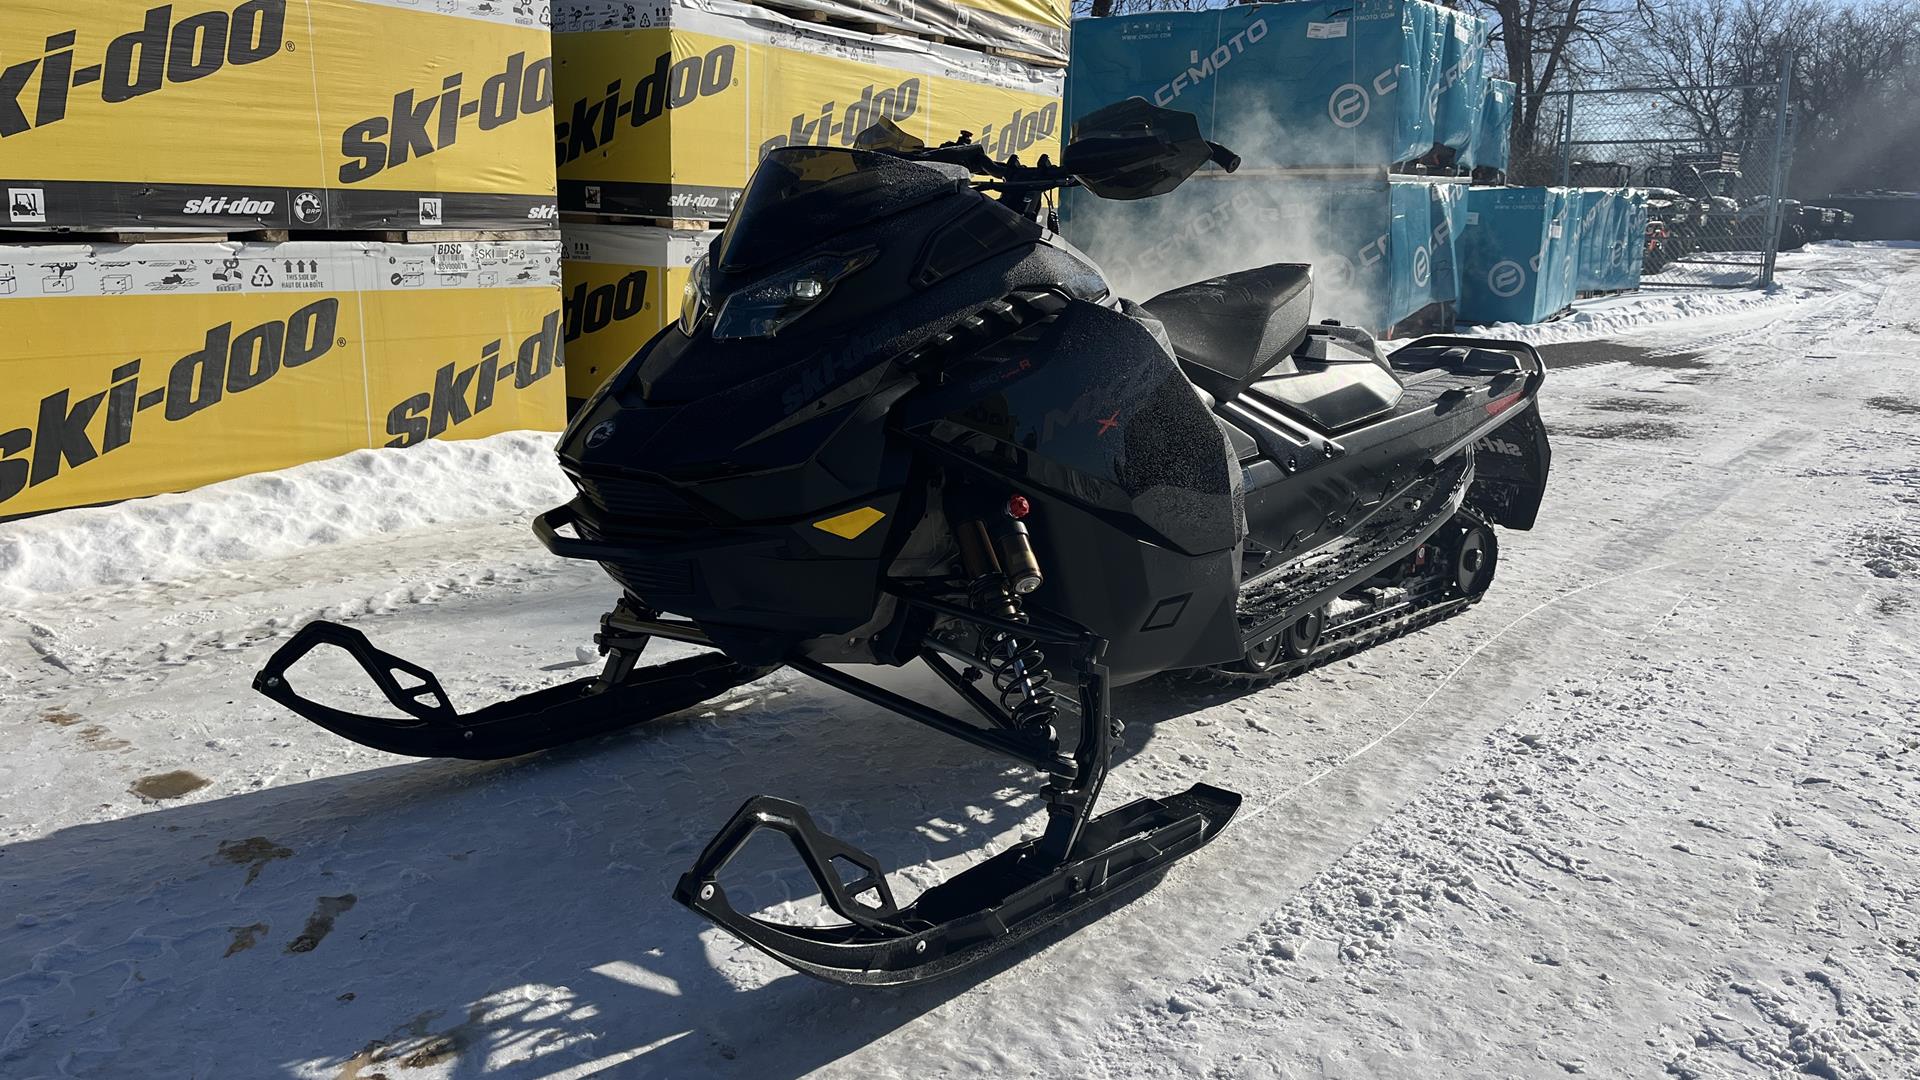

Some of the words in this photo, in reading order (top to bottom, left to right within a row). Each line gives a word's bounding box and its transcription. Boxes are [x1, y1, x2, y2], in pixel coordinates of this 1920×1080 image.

[1154, 18, 1268, 107] CFMOTO
[971, 101, 1058, 162] i-doo
[182, 196, 275, 215] ski-doo
[667, 193, 719, 208] ski-doo
[437, 243, 462, 255] BDSC
[478, 248, 495, 259] SKI
[385, 308, 564, 449] ski-d
